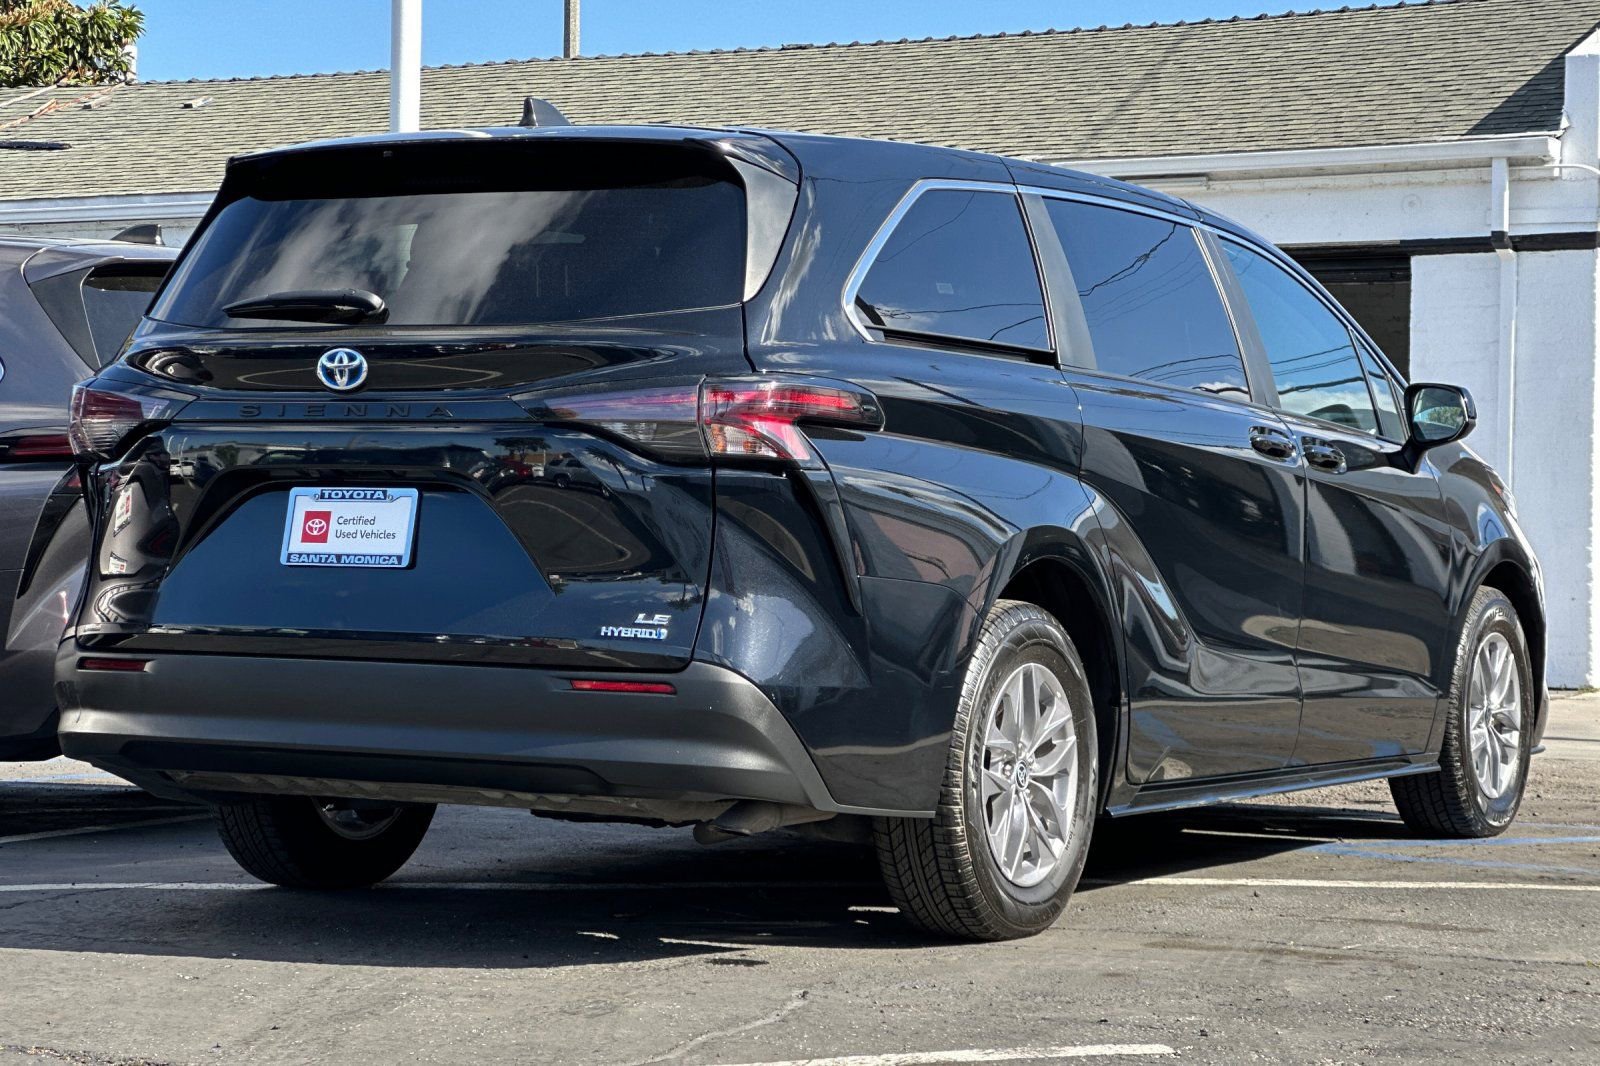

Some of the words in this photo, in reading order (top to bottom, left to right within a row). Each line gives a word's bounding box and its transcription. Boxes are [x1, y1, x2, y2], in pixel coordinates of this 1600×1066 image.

[240, 404, 453, 418] SIENNA
[322, 490, 385, 499] TOYOTA
[337, 516, 376, 526] Certified
[335, 530, 358, 539] Used
[360, 530, 396, 540] Vehicles
[290, 554, 338, 564] SANTA
[340, 555, 399, 565] MONICA
[635, 613, 672, 625] LE
[601, 626, 658, 639] HYBRID
